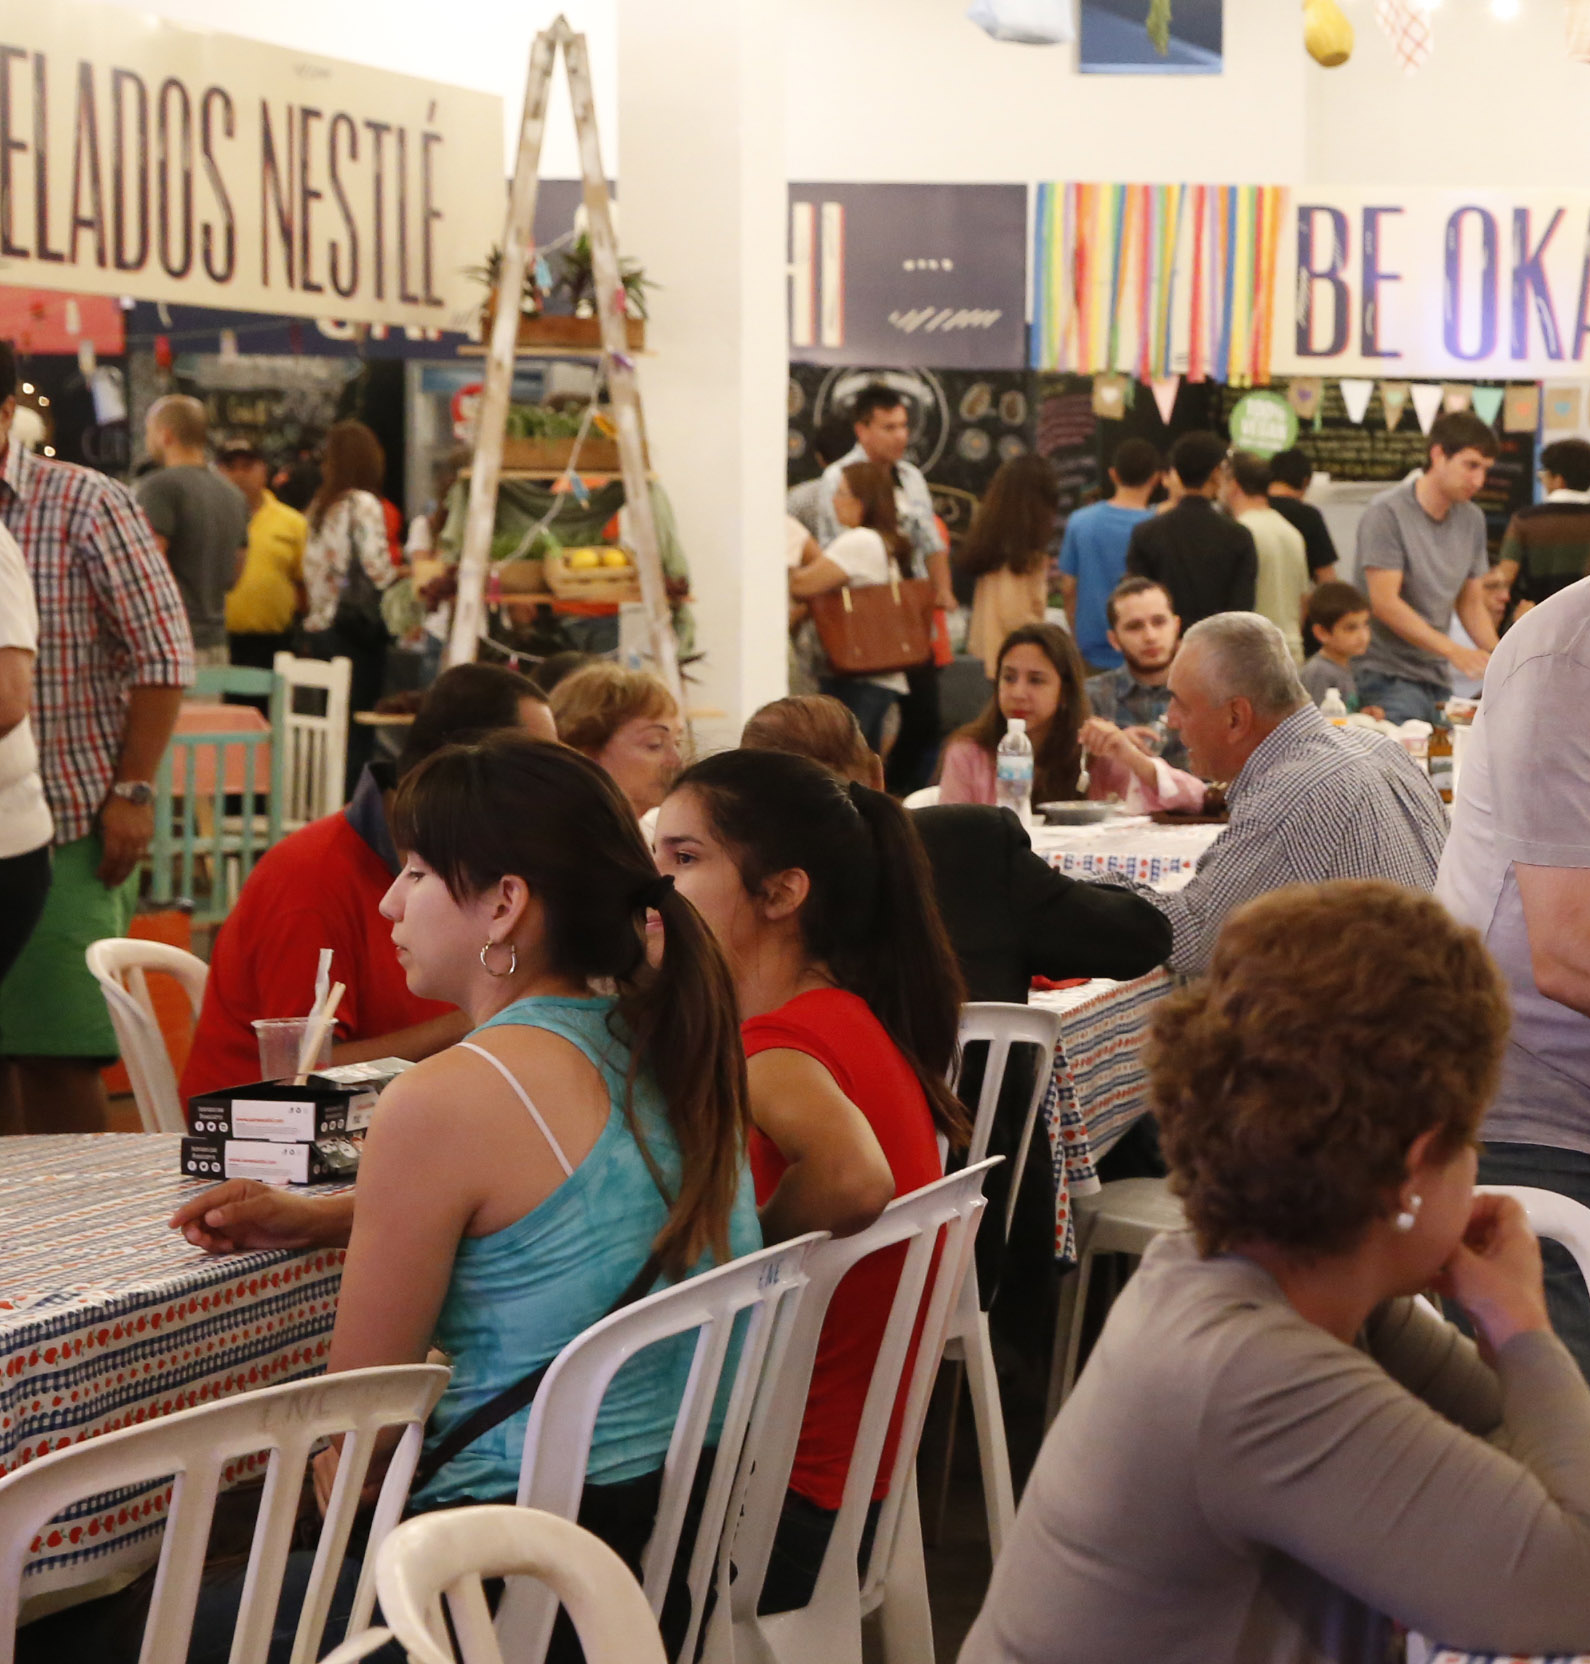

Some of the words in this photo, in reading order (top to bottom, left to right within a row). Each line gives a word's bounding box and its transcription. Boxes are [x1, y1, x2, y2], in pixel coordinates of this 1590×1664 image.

[0, 46, 237, 285] ELADOS
[259, 98, 445, 308] NESTLÉ
[1295, 205, 1405, 358] BE
